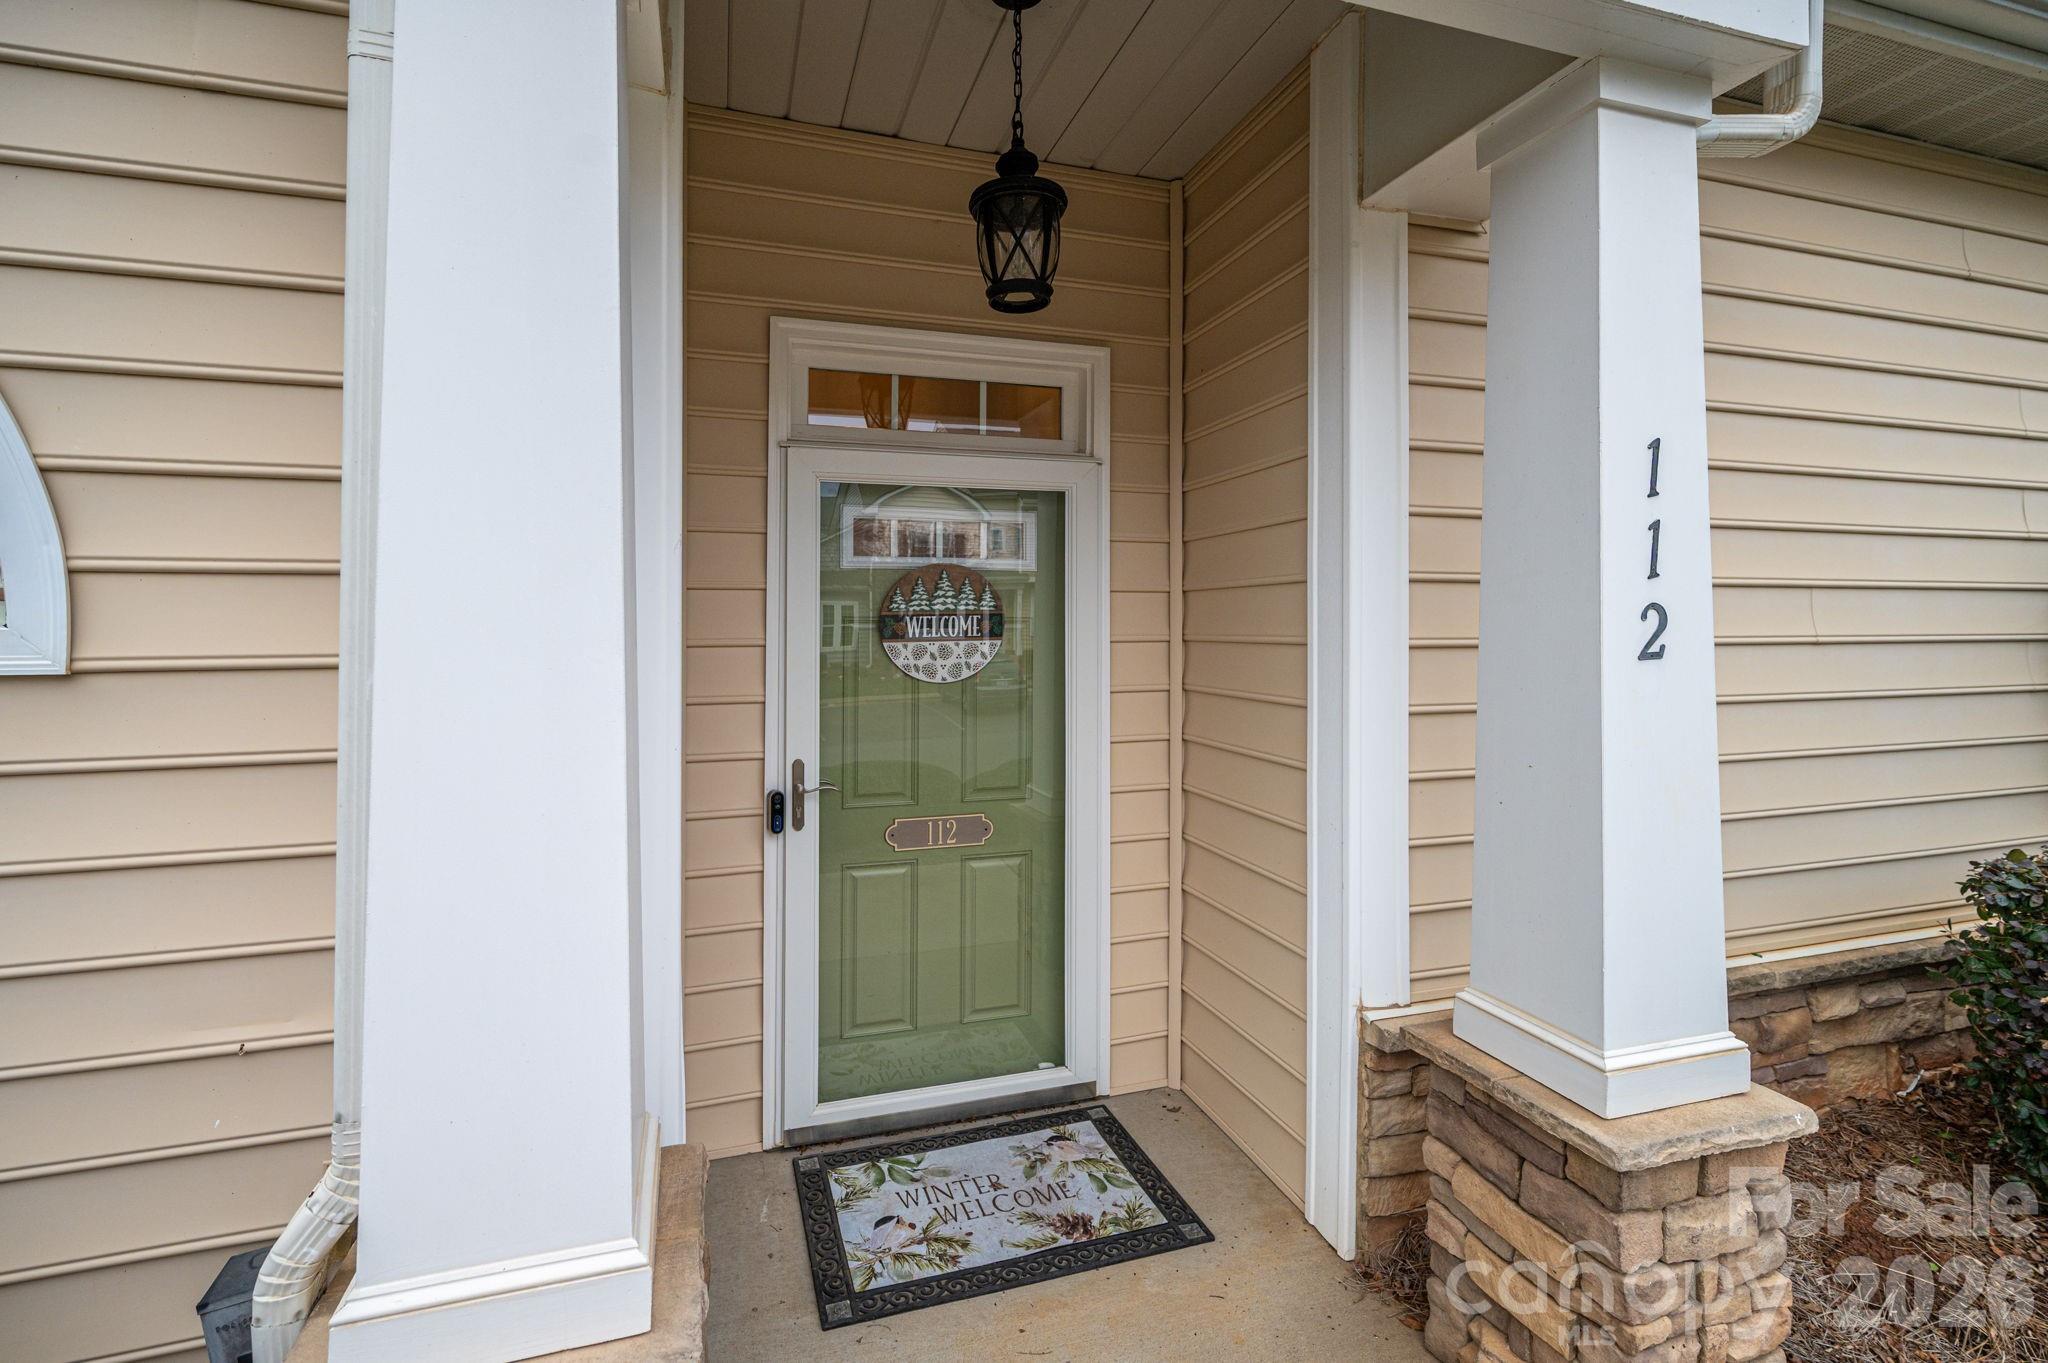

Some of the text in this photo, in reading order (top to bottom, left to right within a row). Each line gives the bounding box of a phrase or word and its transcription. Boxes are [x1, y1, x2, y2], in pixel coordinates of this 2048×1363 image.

[1638, 437, 1668, 661] 112
[906, 615, 981, 638] WELCOME
[927, 820, 957, 845] 112
[895, 1174, 1008, 1209] WINTER
[932, 1180, 1077, 1225] WELCOME
